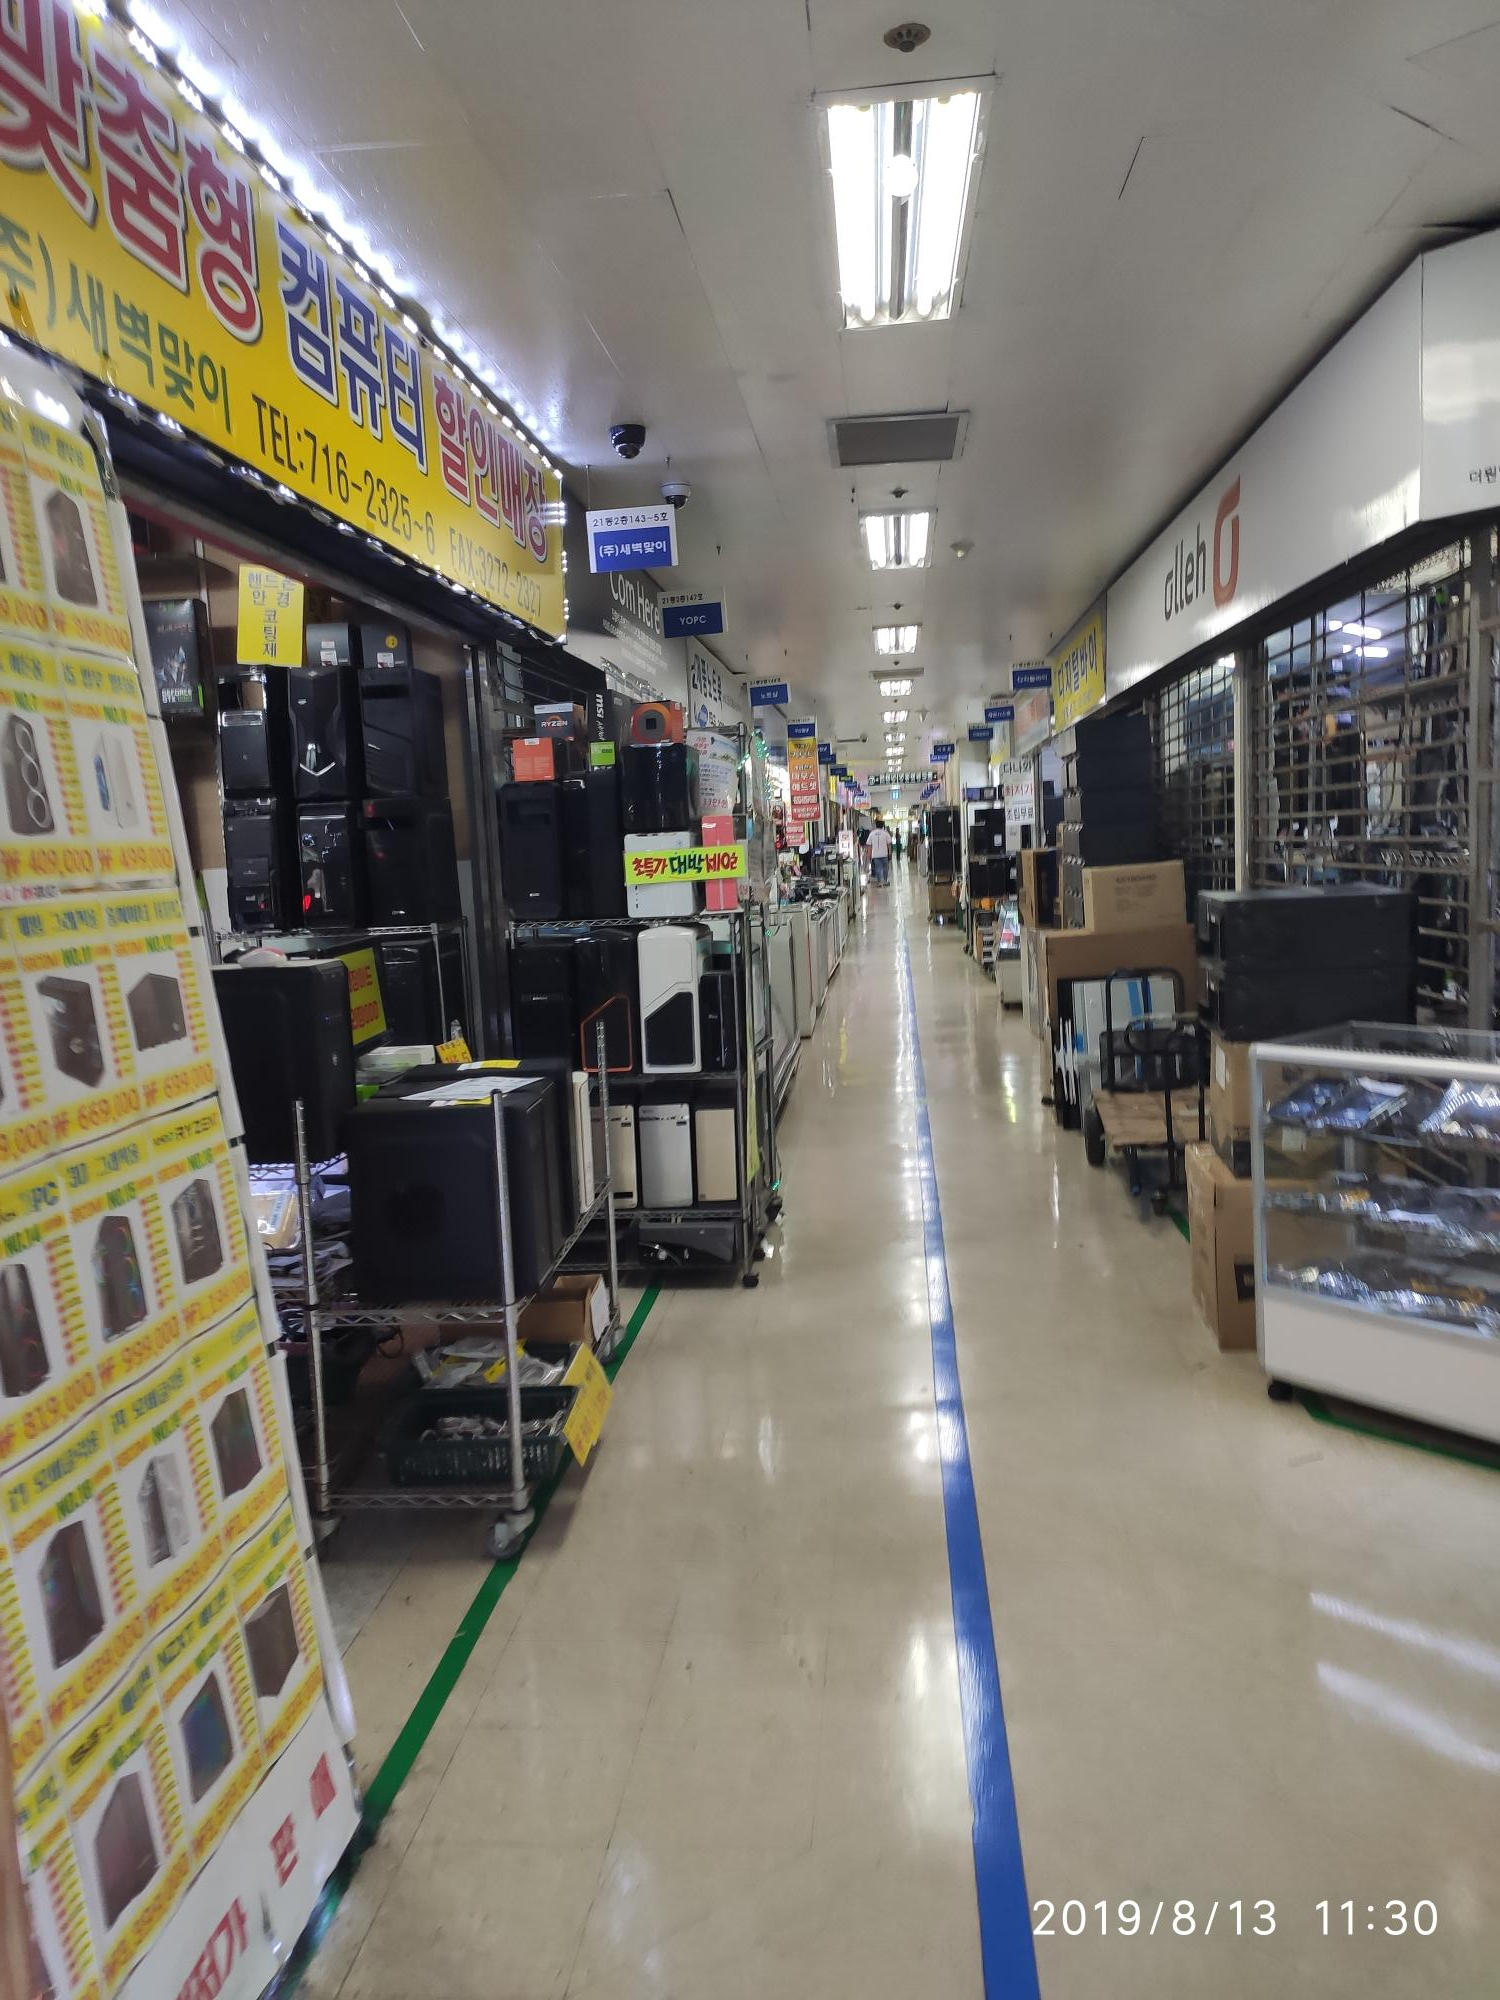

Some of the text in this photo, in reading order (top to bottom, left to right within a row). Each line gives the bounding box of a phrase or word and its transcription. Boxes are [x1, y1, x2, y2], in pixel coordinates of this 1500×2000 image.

[274, 206, 429, 475] 컴퓨터
[432, 373, 548, 563] 할인매장
[252, 394, 436, 556] TEL:716-2325~6
[593, 512, 669, 527] 21동2층143-5호
[599, 540, 667, 558] (주)새벽맞이
[609, 571, 660, 635] Com Here
[680, 615, 707, 625] YOPC
[541, 719, 568, 728] RYZEN
[1003, 761, 1032, 775] 다나와
[632, 856, 668, 879] 초특가
